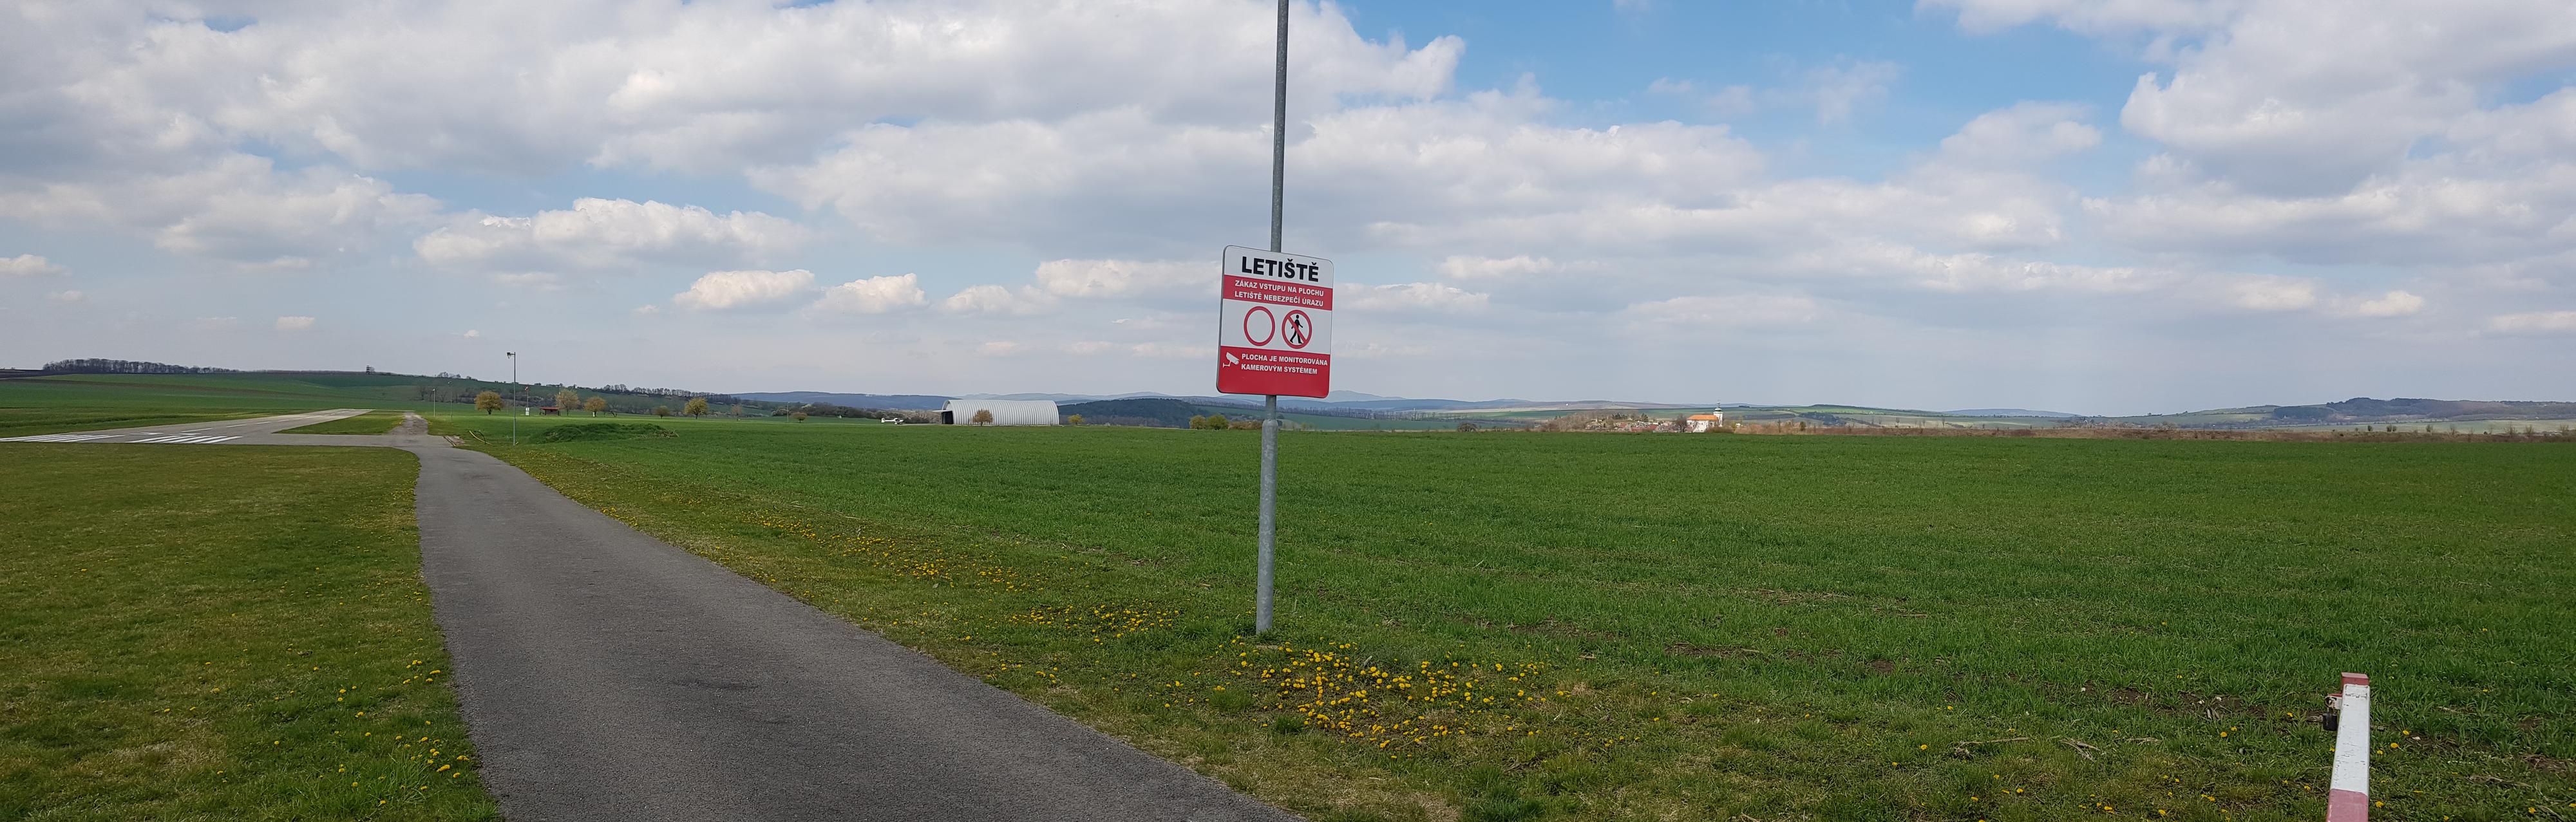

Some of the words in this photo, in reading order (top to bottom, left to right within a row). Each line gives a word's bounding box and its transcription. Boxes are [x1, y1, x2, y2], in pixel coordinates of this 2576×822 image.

[1242, 256, 1319, 282] LETIŠTĚ
[1235, 279, 1258, 288] ZÁKAZ
[1259, 283, 1286, 291] VSTUPU
[1298, 287, 1324, 297] PLOCHU
[1235, 290, 1262, 300] LETIŠTĚ
[1264, 294, 1300, 304] NEBEZPEČÍ
[1302, 297, 1323, 307] ÚRAZU
[1241, 364, 1282, 372] KAMEROVÝM
[1283, 366, 1318, 374] SYSTÉMEM
[1278, 356, 1328, 366] MONITOROVÁNA
